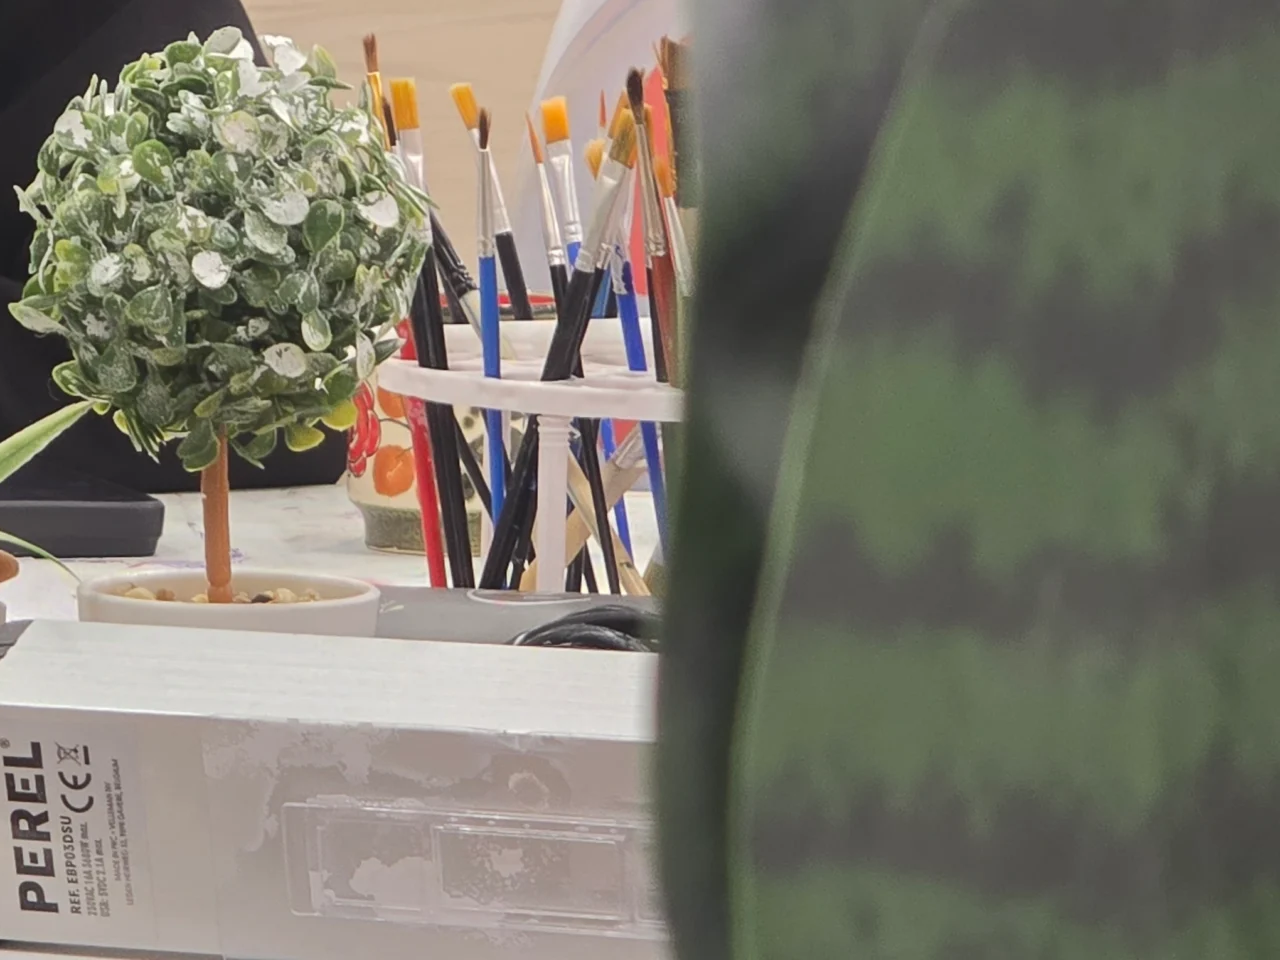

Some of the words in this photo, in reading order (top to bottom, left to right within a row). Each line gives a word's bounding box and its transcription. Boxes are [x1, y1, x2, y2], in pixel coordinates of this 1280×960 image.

[2, 741, 59, 914] PEREL
[60, 815, 79, 885] EBP03DSU
[70, 889, 82, 915] REF.
